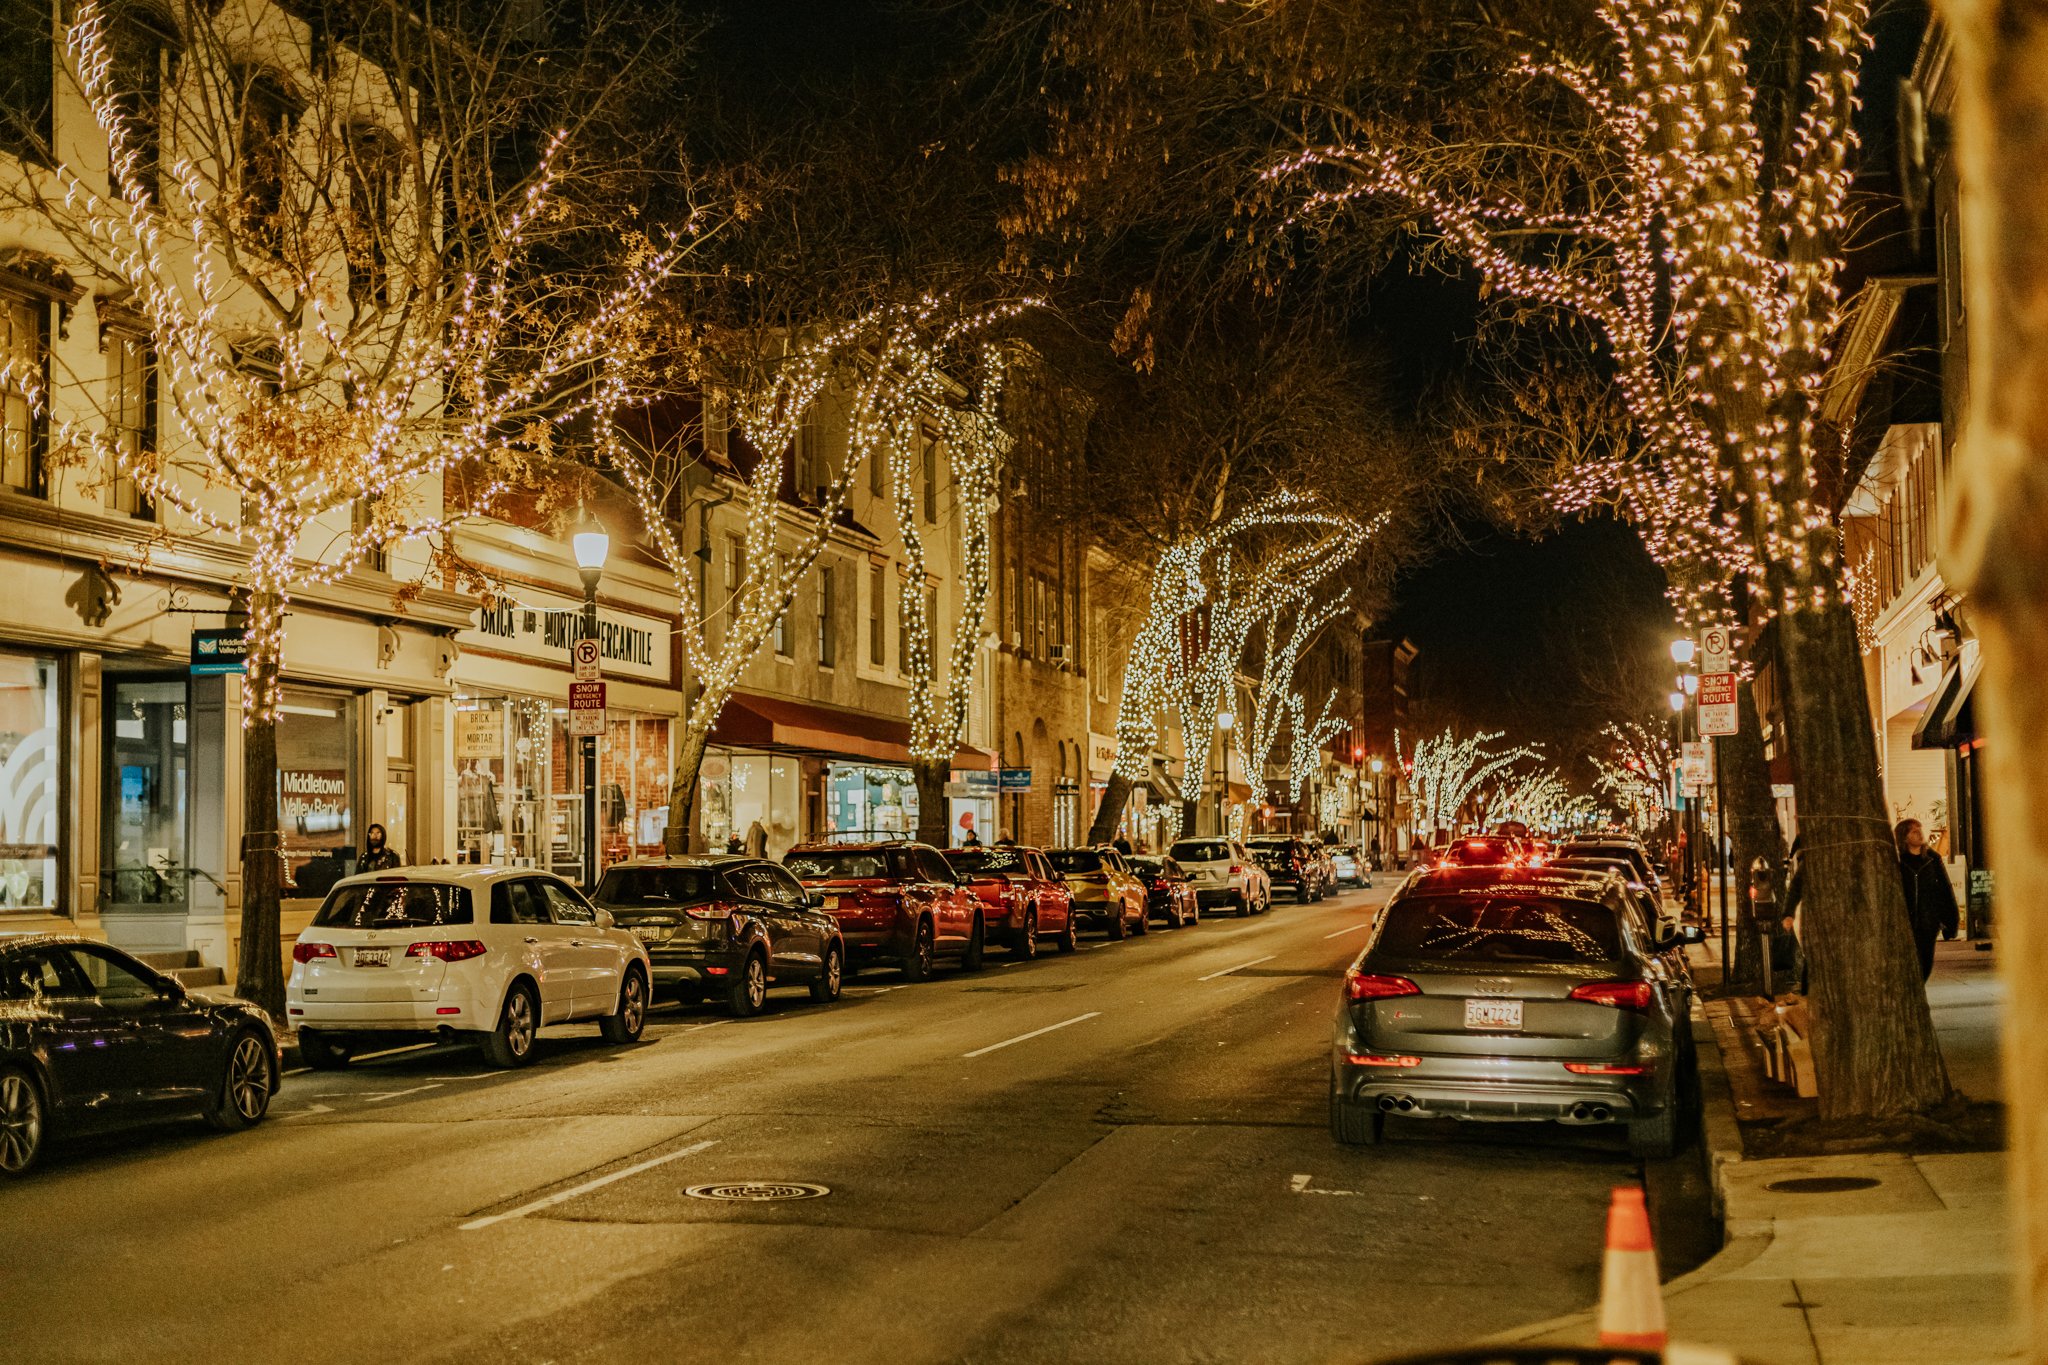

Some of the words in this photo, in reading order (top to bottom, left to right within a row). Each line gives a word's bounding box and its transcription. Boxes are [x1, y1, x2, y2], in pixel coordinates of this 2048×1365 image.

[480, 596, 516, 639] BRICK
[1704, 675, 1730, 687] SNOW
[575, 684, 600, 694] SNOW
[1702, 685, 1732, 694] EMERGENCY
[573, 699, 601, 709] ROUTE
[1702, 692, 1732, 704] ROUTE
[470, 713, 490, 724] BRICK
[466, 733, 493, 744] MORTAR
[1140, 765, 1150, 778] 5
[283, 771, 345, 795] Middletown
[283, 797, 314, 818] Valley
[314, 798, 340, 818] Bank
